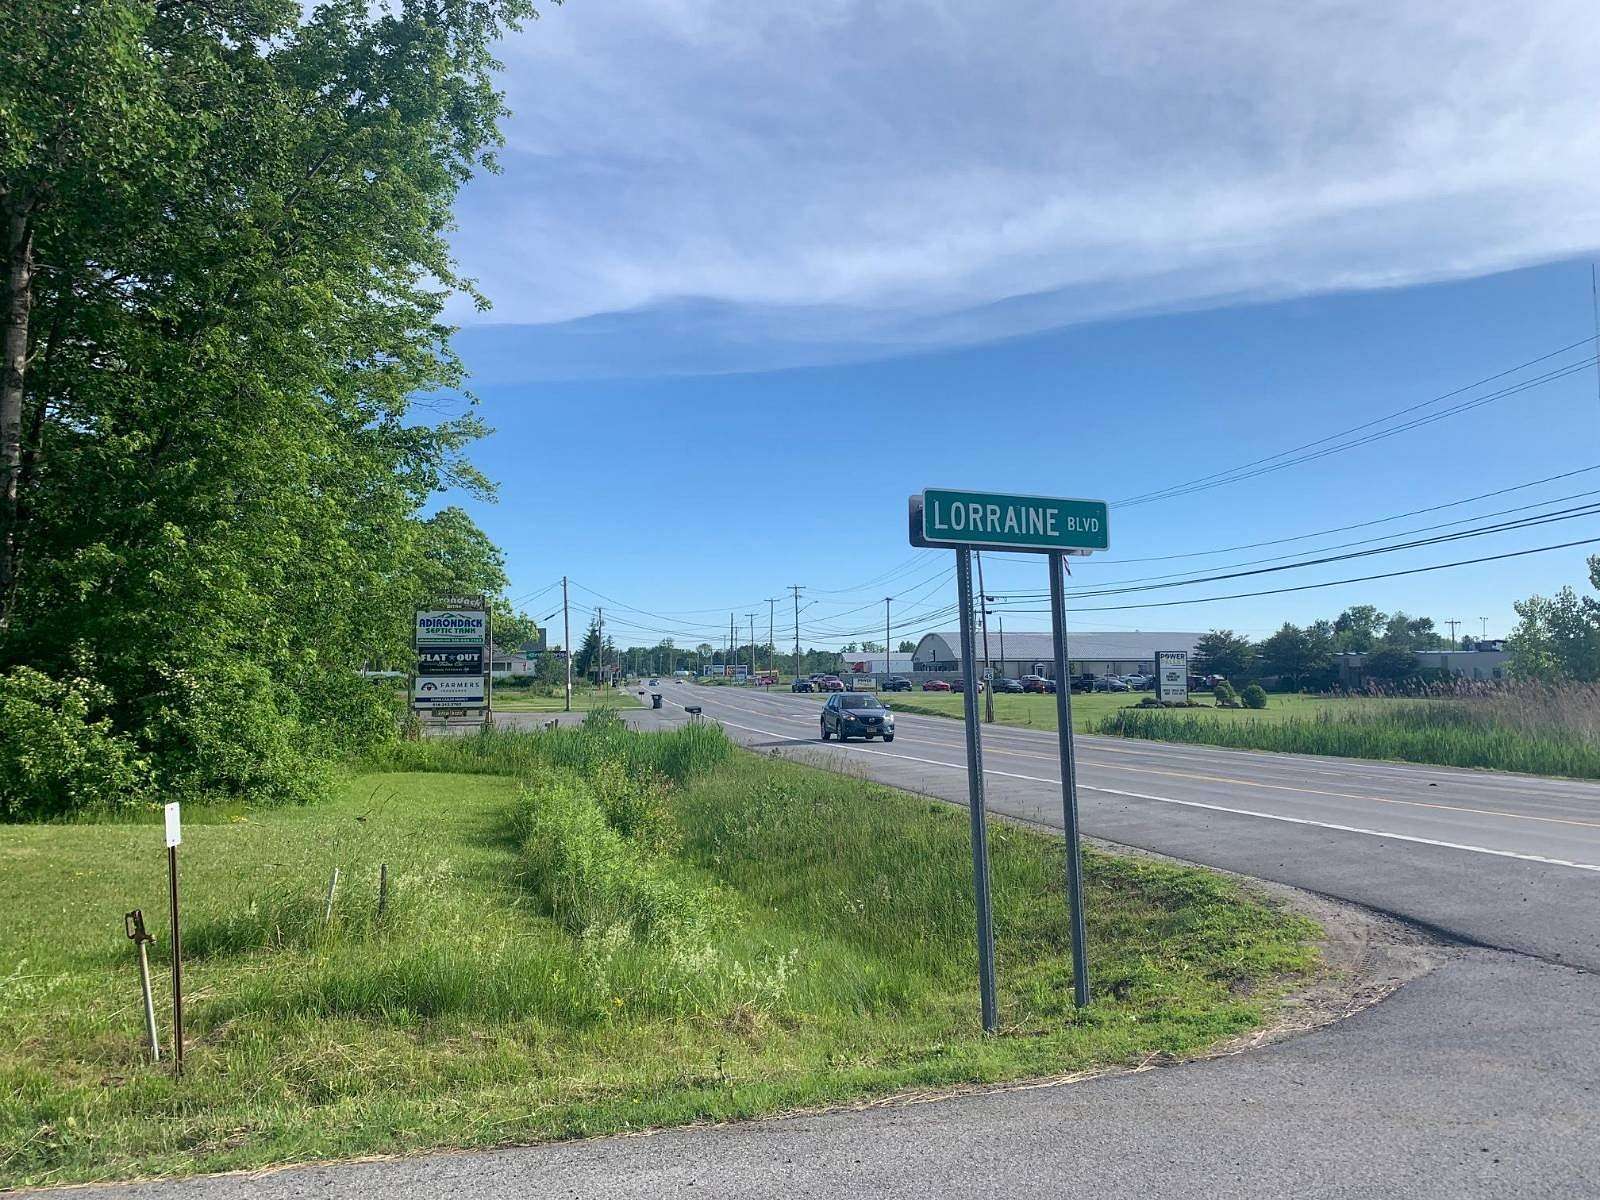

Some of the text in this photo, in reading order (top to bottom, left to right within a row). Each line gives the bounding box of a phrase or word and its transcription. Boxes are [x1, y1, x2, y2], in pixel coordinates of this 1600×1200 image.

[934, 500, 1099, 537] LORRAINE BLVD
[419, 618, 482, 628] ADIRONDACK
[420, 653, 481, 661] FLAT OUT
